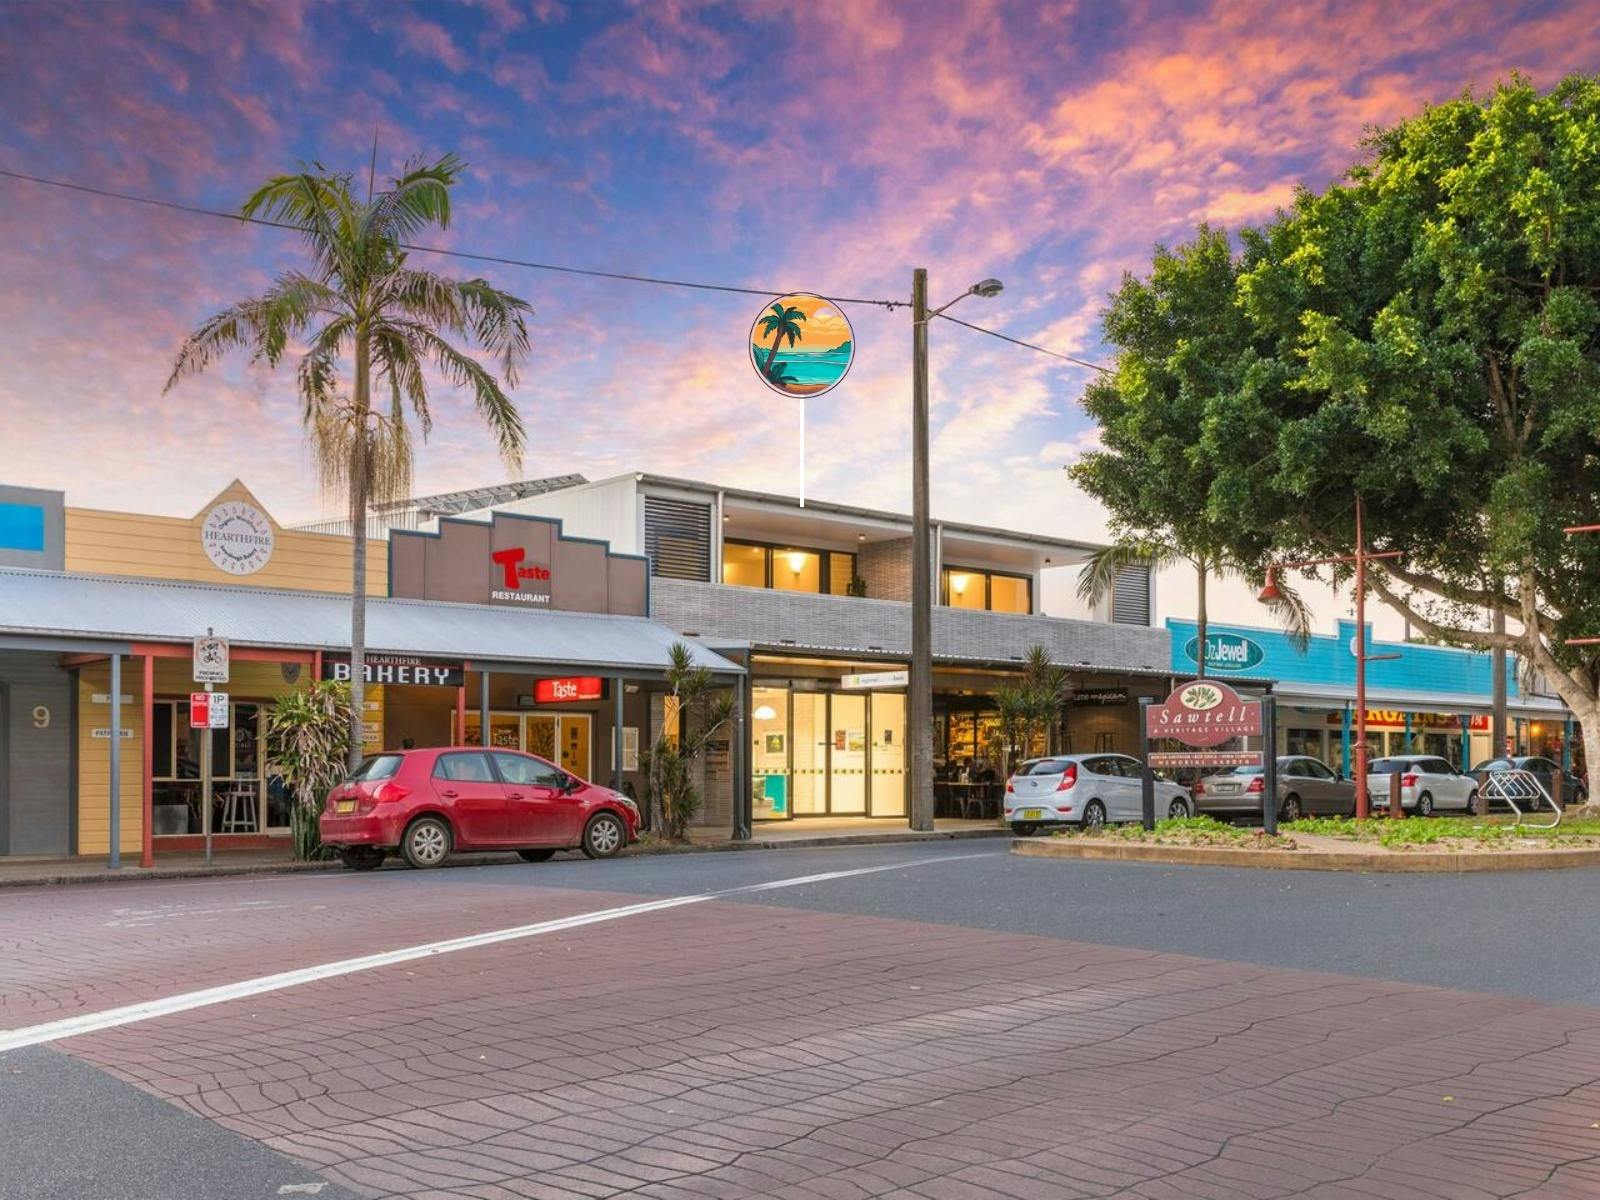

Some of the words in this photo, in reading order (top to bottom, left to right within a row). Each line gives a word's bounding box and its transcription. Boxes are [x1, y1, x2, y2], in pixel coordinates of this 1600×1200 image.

[205, 531, 271, 546] HEARTHFIRE
[492, 547, 550, 590] Taste
[491, 590, 550, 603] RESTAURANT
[366, 655, 421, 665] HEARTHFIRE
[334, 663, 449, 684] BAKERY
[552, 681, 577, 698] Taste
[213, 695, 225, 704] 1P
[32, 705, 51, 728] 9
[1159, 705, 1246, 725] Sawtell
